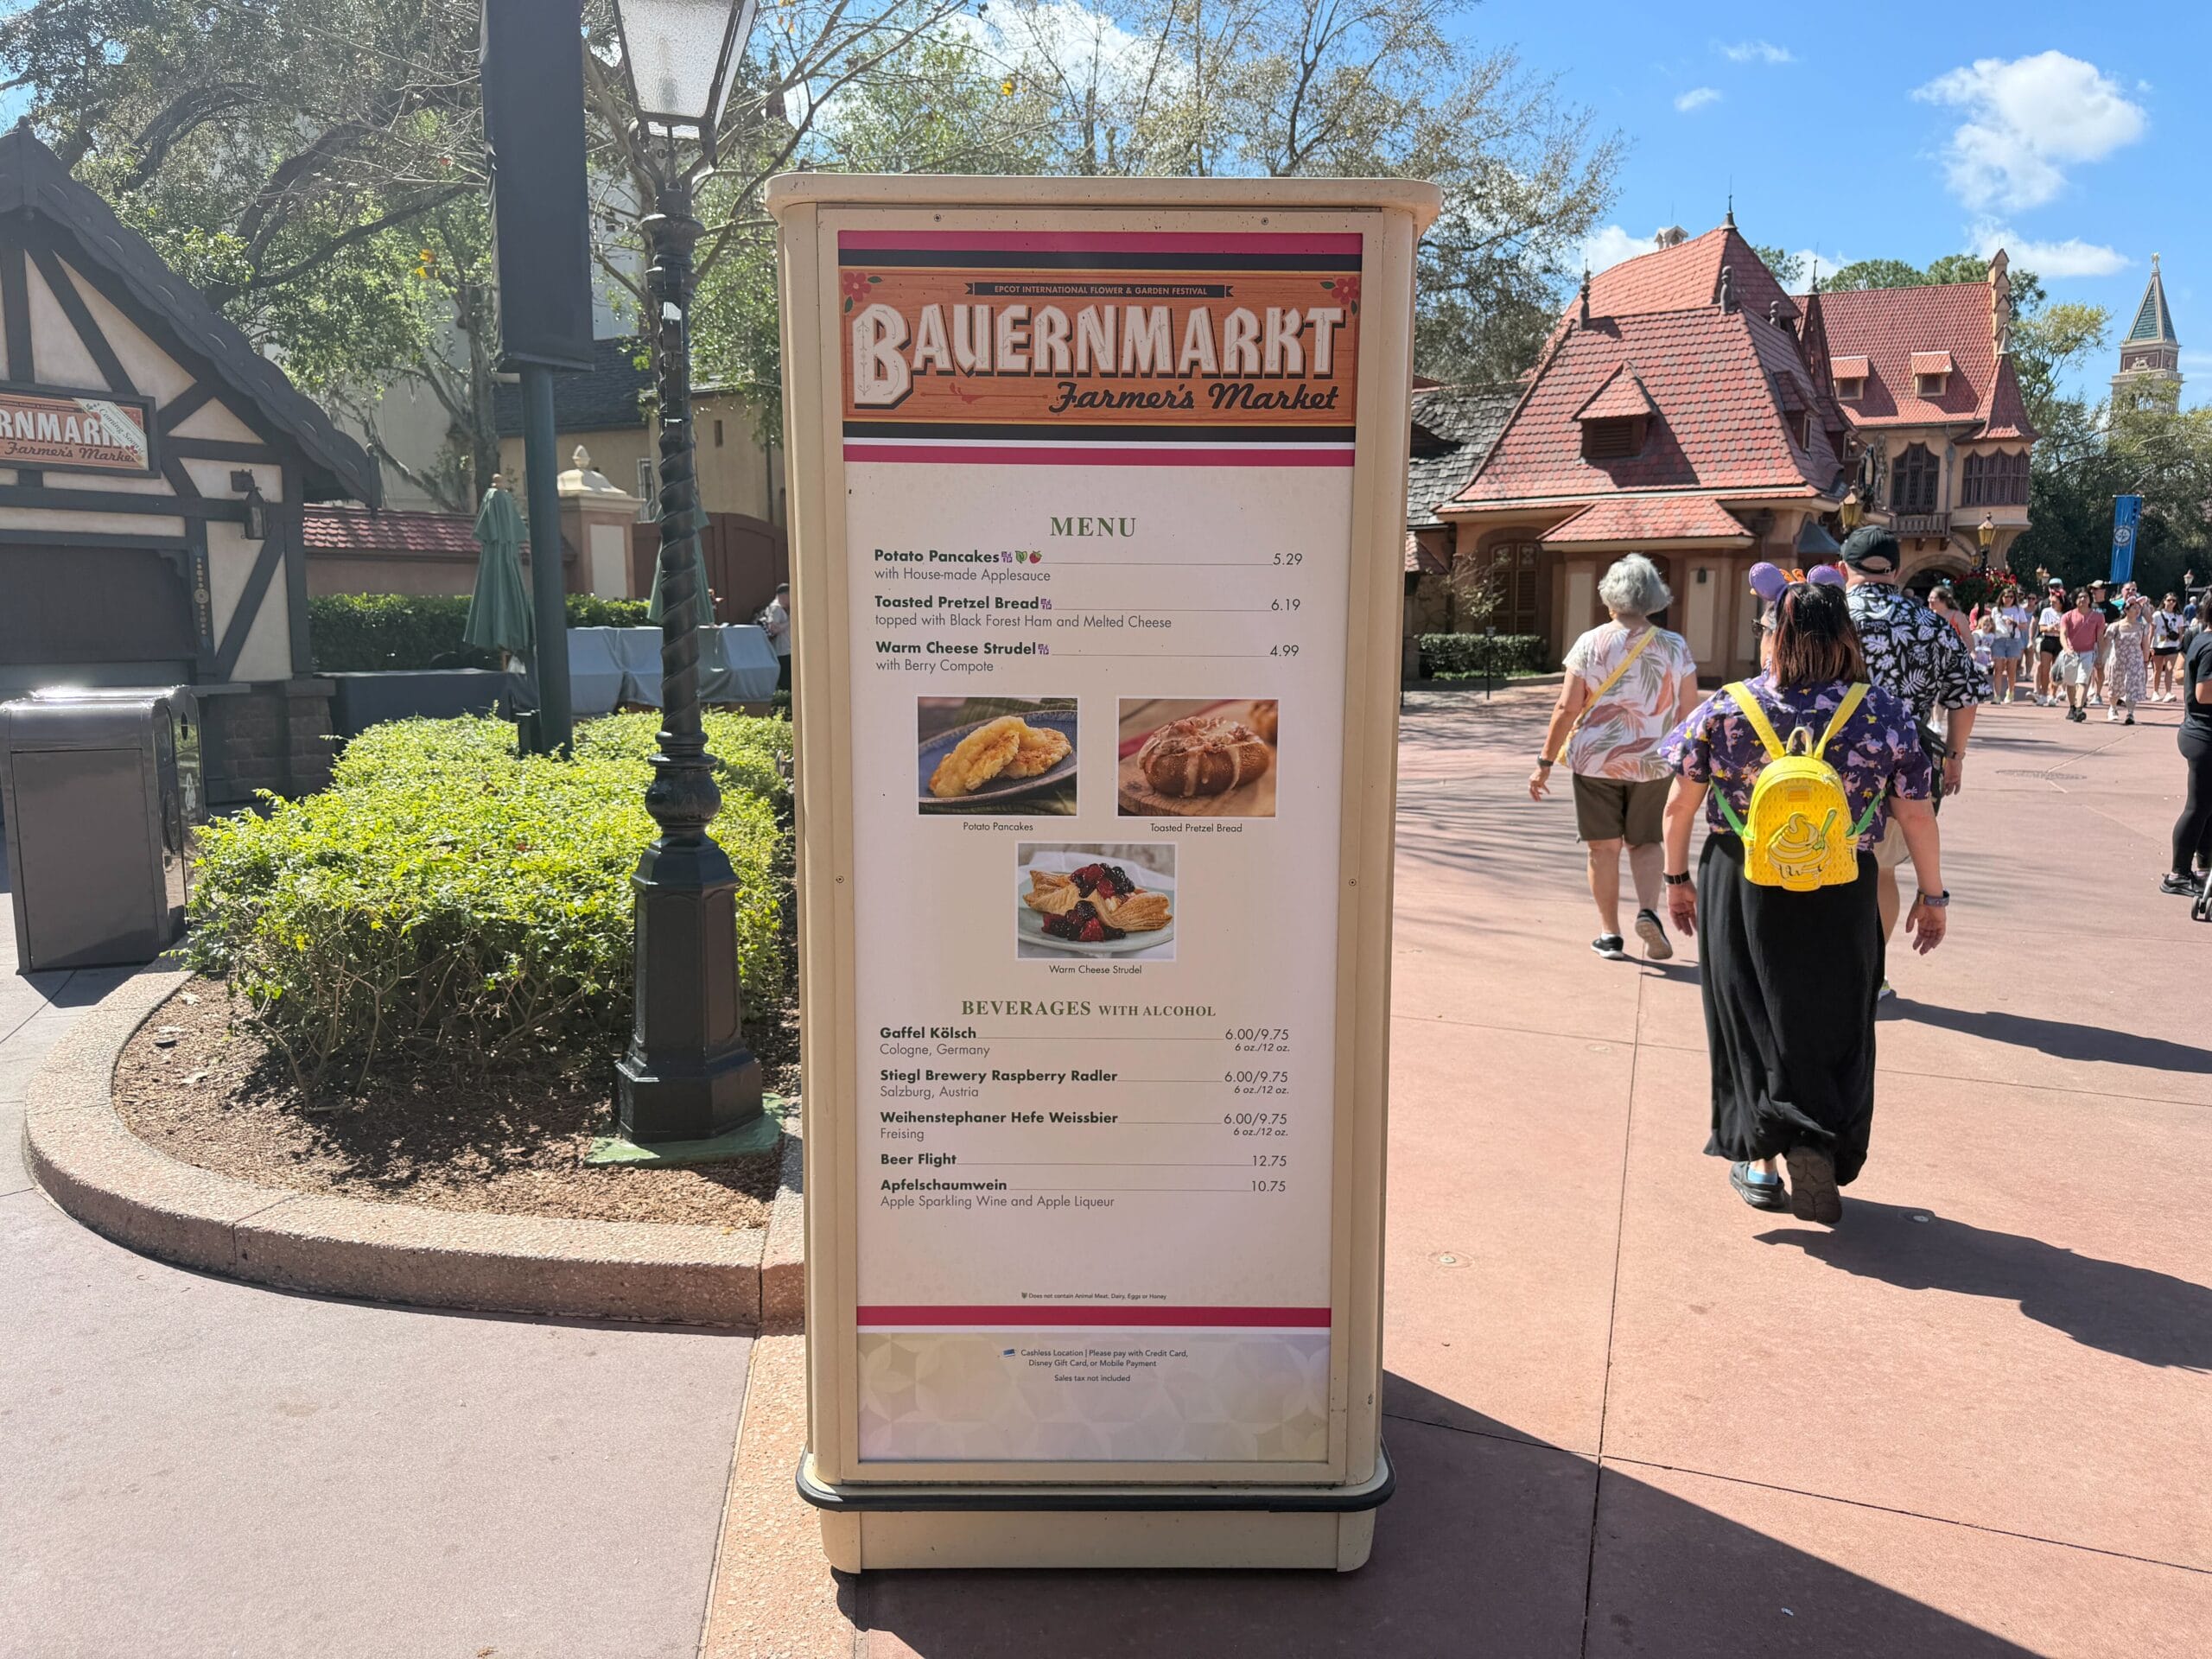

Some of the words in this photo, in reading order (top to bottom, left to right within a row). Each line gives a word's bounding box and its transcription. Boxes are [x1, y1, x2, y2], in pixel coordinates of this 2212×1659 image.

[1022, 285, 1089, 295] INTERNATIONAL
[1090, 286, 1123, 295] FLOWER
[1125, 286, 1133, 295] &
[1135, 286, 1170, 295] GARDEN
[1172, 287, 1208, 296] FESTIVAL
[853, 303, 1345, 409] BAUERNMARKT
[1049, 381, 1195, 413] Farmer's
[1209, 383, 1338, 410] Market
[99, 408, 124, 435] Coming
[4, 442, 73, 458] Farmer's
[79, 447, 137, 462] Marke
[1050, 517, 1137, 537] MENU
[874, 549, 924, 563] Potato
[929, 549, 1000, 563] Pancakes
[1273, 552, 1303, 566] 5.29
[874, 566, 899, 580] with
[903, 567, 977, 581] House-made
[981, 567, 1052, 585] Applesauce
[874, 594, 933, 608] Toasted
[938, 595, 989, 609] Pretzel
[995, 595, 1039, 610] Bread
[1271, 598, 1301, 611] 6.19
[874, 612, 917, 629] topped
[921, 612, 946, 626] with
[950, 613, 982, 626] Black
[986, 613, 1021, 627] Forest
[1024, 614, 1052, 627] Ham
[1056, 613, 1079, 627] and
[1083, 614, 1124, 628] Melted
[1128, 614, 1172, 628] Cheese
[875, 640, 921, 654] Warm
[925, 640, 979, 655] Cheese
[983, 641, 1036, 655] Strudel
[1269, 645, 1300, 658] 4.99
[875, 657, 900, 671] with
[905, 658, 937, 675] Berry
[939, 658, 994, 676] Compote
[963, 821, 990, 831] Potato
[993, 821, 1033, 831] Pancakes
[1149, 823, 1183, 832] Toasted
[1185, 823, 1214, 833] Pretzel
[1217, 823, 1243, 833] Bread
[1048, 964, 1076, 974] Warm
[1077, 964, 1110, 974] Cheese
[1112, 964, 1142, 975] Strudel
[961, 1000, 1091, 1016] BEVERAGES
[1098, 1005, 1138, 1016] WITH
[1142, 1005, 1217, 1017] ALCOHOL
[880, 1026, 925, 1039] Gaffel
[930, 1026, 976, 1039] Kölsch
[1224, 1027, 1289, 1042] 6.00/9.75
[879, 1042, 932, 1058] Cologne,
[936, 1043, 990, 1058] Germany
[1235, 1043, 1242, 1052] 6
[880, 1068, 921, 1084] Stiegl
[925, 1069, 988, 1084] Brewery
[991, 1068, 1066, 1084] Raspberry
[1071, 1069, 1118, 1082] Radler
[1224, 1070, 1288, 1084] 6.00/9.75
[880, 1084, 935, 1101] Salzburg,
[938, 1085, 979, 1097] Austria
[1234, 1084, 1241, 1094] 6
[880, 1110, 1007, 1127] Weihenstephaner
[1011, 1110, 1045, 1123] Hefe
[1048, 1110, 1119, 1124] Weissbier
[1224, 1112, 1287, 1127] 6.00/9.75
[880, 1127, 925, 1142] Freising
[1233, 1127, 1240, 1136] 6
[880, 1154, 914, 1165] Beer
[918, 1152, 957, 1168] Flight
[1252, 1154, 1287, 1167] 12.75
[880, 1178, 1007, 1194] Apfelschaumwein
[1251, 1180, 1286, 1192] 10.75
[880, 1194, 915, 1211] Apple
[918, 1194, 972, 1211] Sparkling
[976, 1195, 1007, 1207] Wine
[1010, 1194, 1033, 1207] and
[1036, 1194, 1071, 1210] Apple
[1074, 1195, 1115, 1211] Liqueur
[1113, 1351, 1127, 1359] pay
[1128, 1349, 1144, 1357] with
[1144, 1349, 1167, 1357] Credit
[1168, 1349, 1189, 1358] Card,
[1028, 1359, 1053, 1369] Disney
[1053, 1358, 1068, 1367] Gift
[1069, 1358, 1090, 1368] Card,
[1125, 1359, 1157, 1369] Payment
[1100, 1374, 1131, 1382] included
